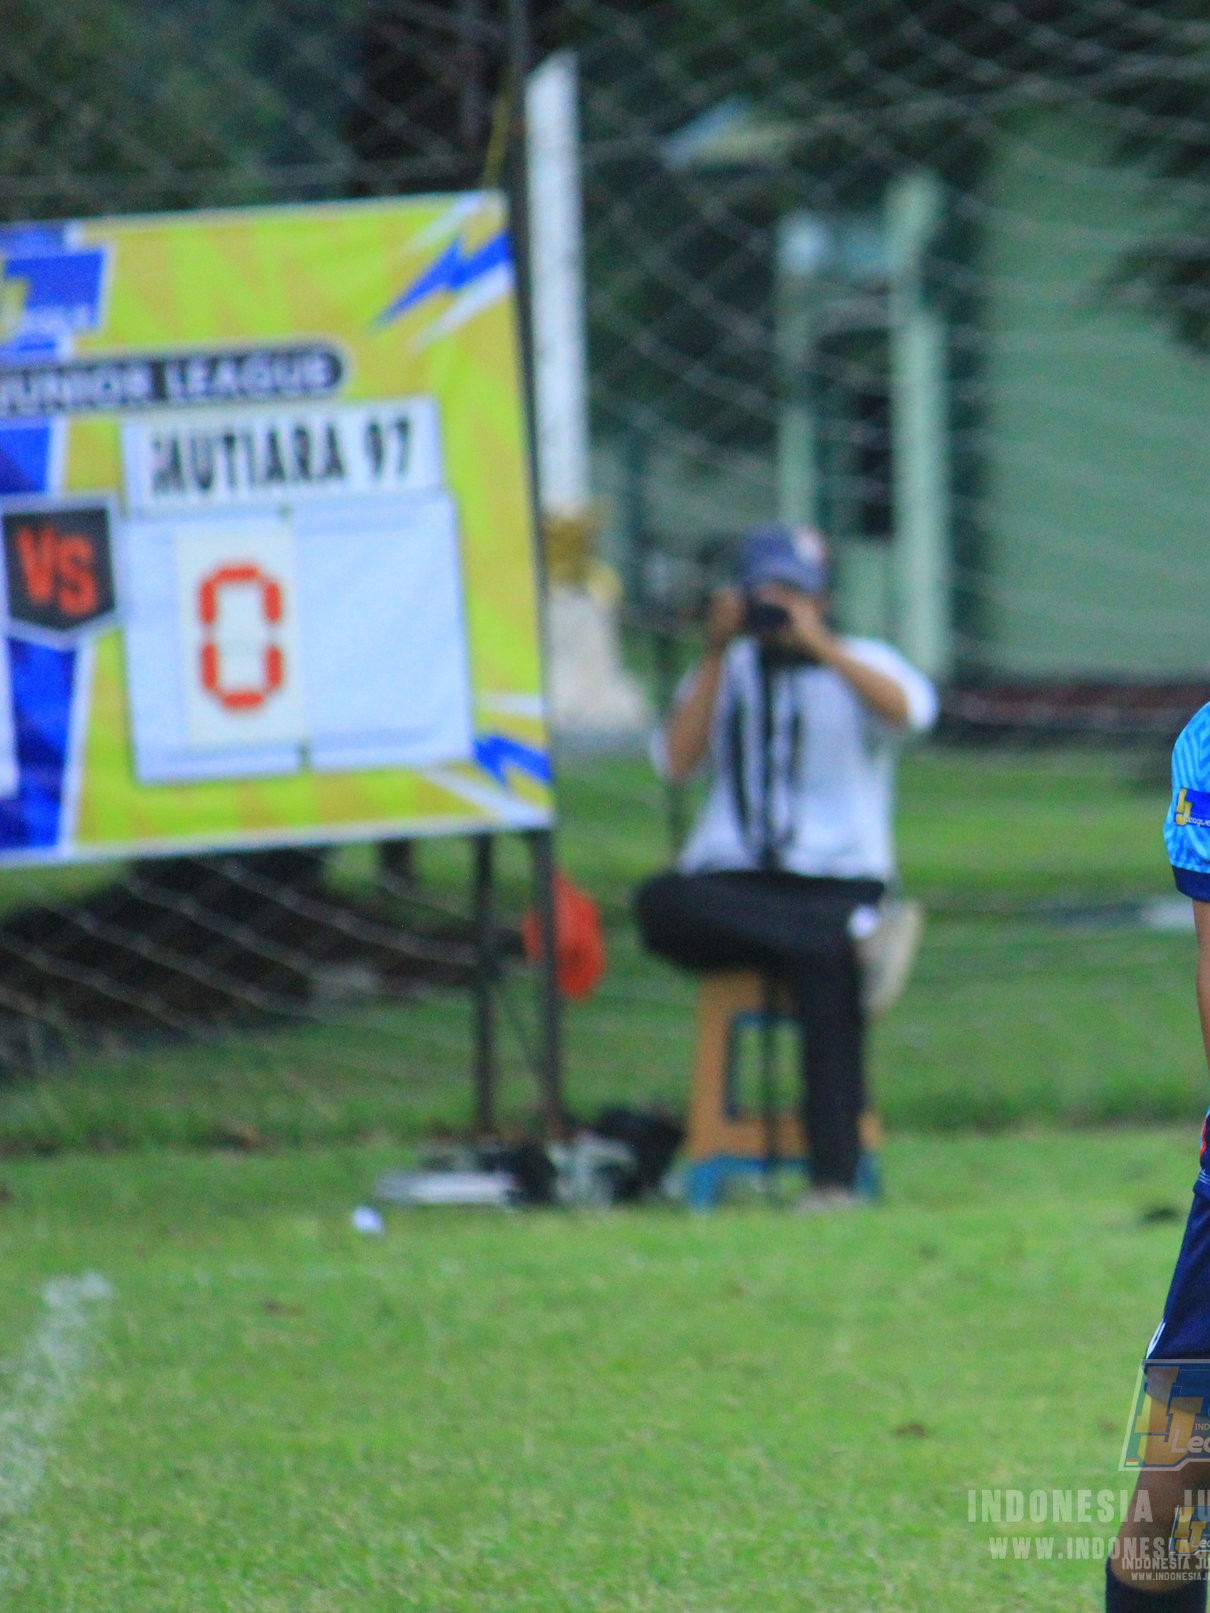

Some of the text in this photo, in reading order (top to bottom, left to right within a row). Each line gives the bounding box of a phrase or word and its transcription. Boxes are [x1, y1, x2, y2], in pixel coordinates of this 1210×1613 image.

[164, 352, 333, 400] LEAGUE
[152, 415, 409, 492] MUTIARA 97
[17, 525, 98, 616] VS
[197, 564, 282, 710] 0
